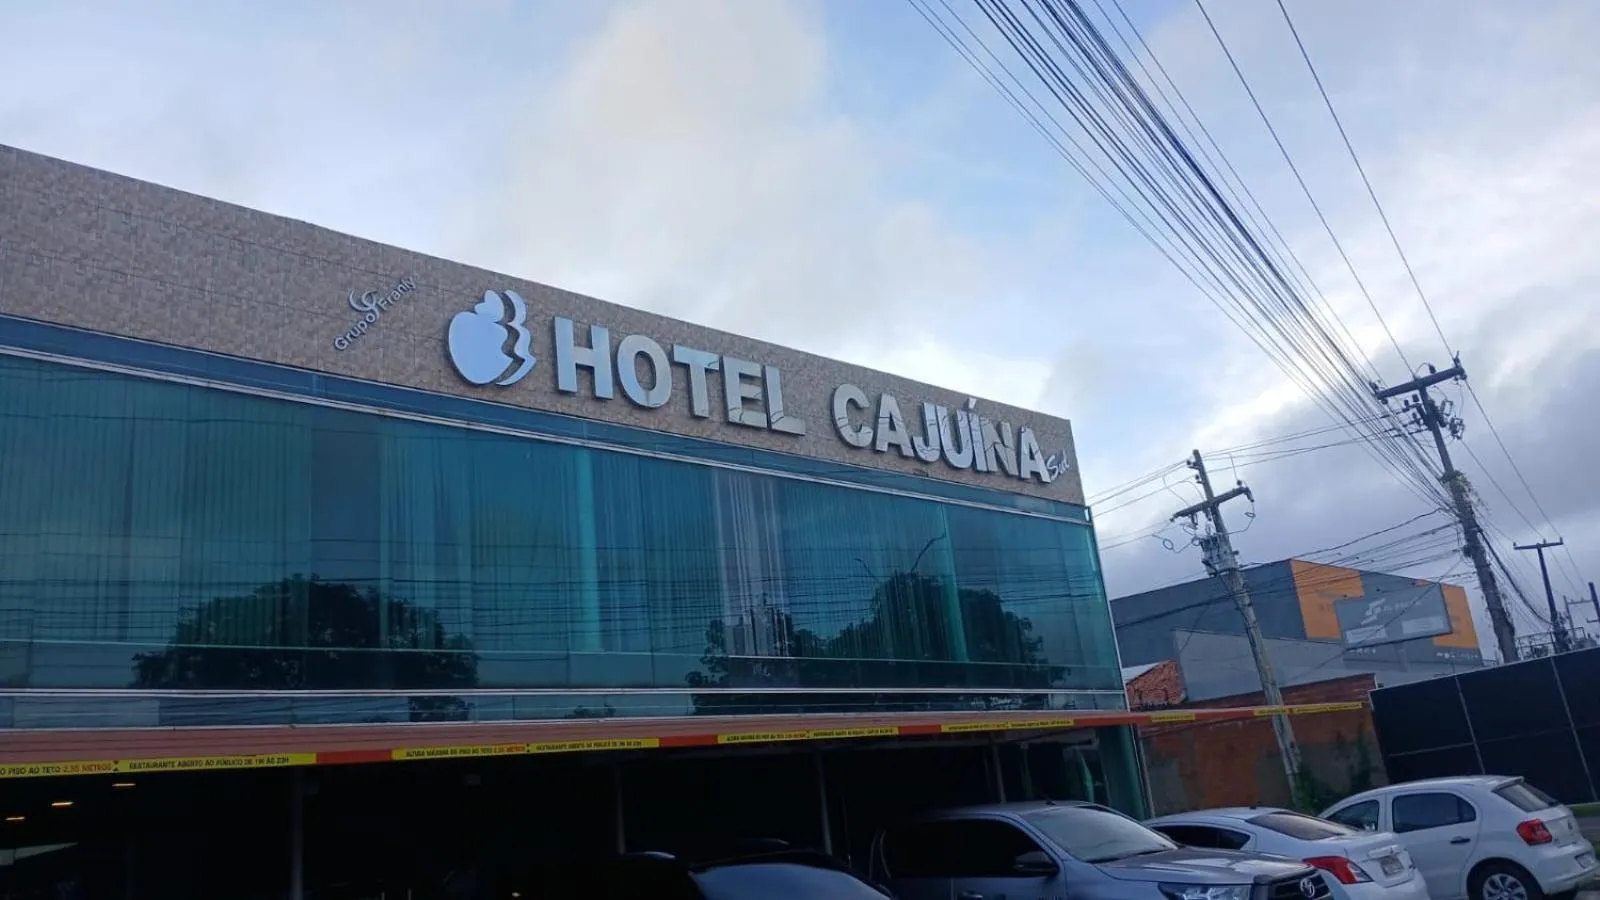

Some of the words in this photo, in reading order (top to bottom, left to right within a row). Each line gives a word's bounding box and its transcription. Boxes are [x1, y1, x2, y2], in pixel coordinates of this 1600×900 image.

[334, 312, 377, 350] Grupo
[377, 276, 417, 312] Franly
[553, 316, 806, 436] HOTEL
[832, 383, 1051, 483] CAJUÍNA
